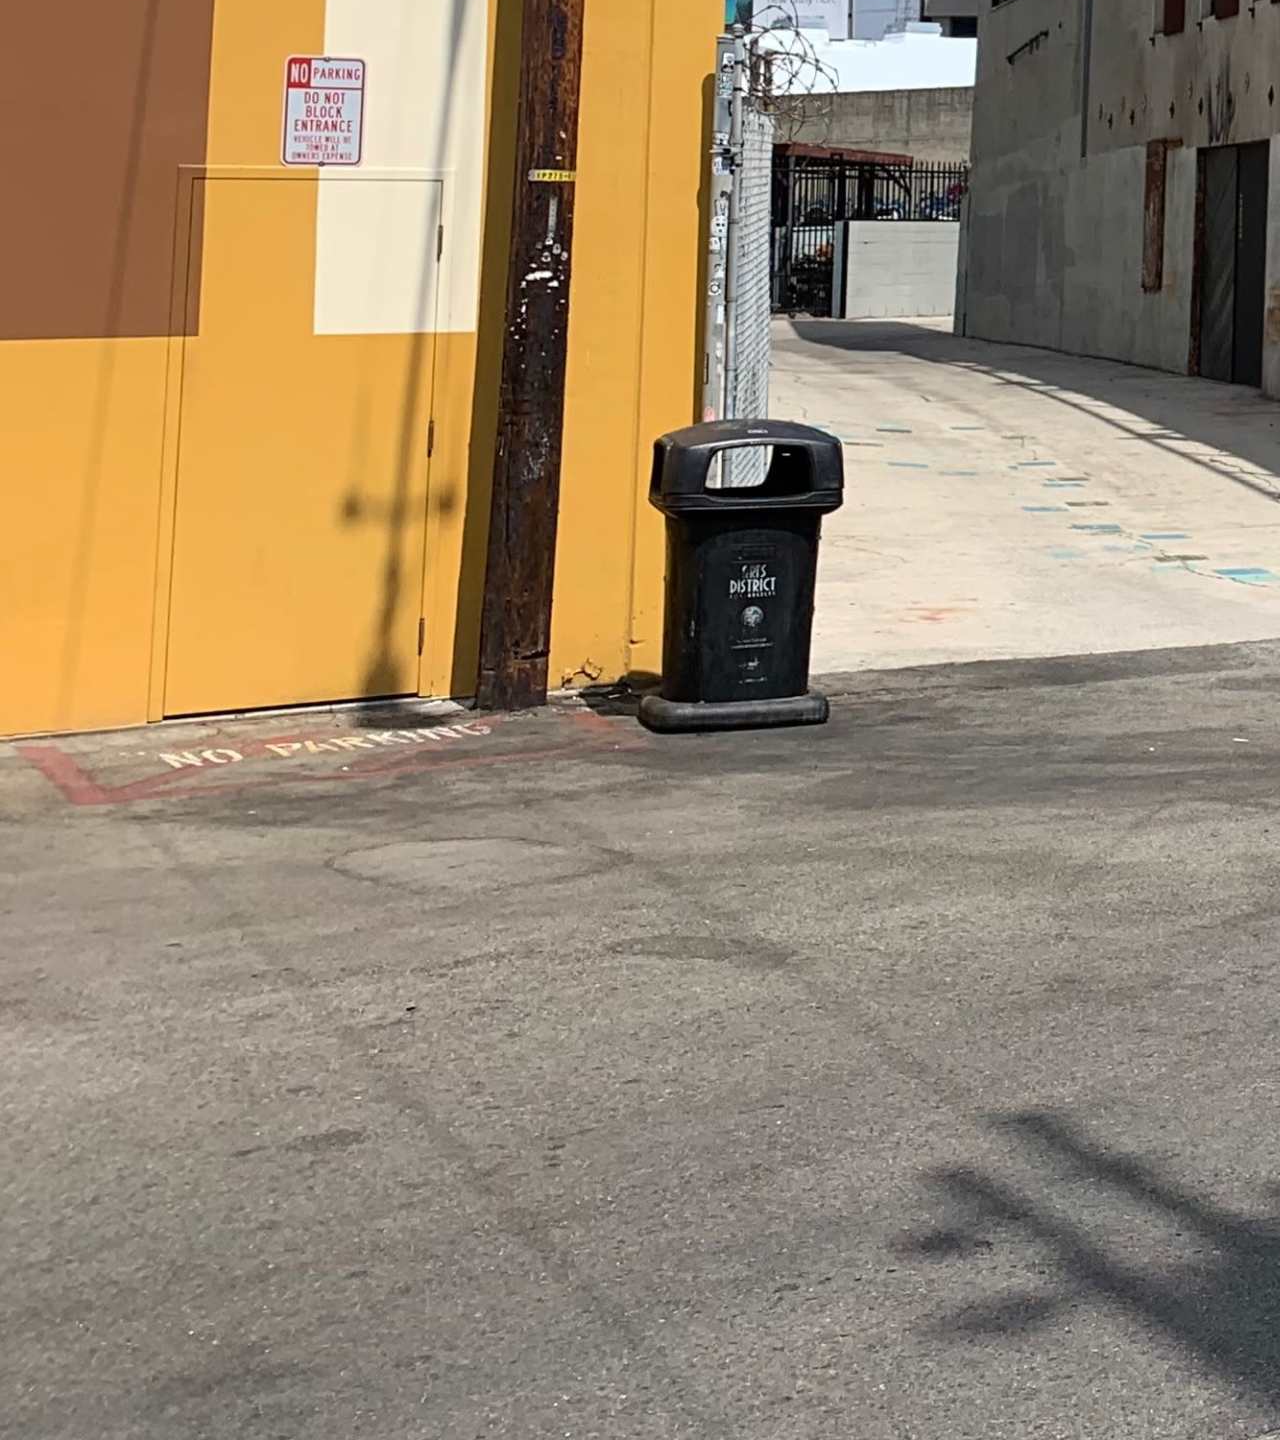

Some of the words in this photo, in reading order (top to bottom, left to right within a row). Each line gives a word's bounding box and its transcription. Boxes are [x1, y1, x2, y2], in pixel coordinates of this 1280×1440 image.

[290, 63, 309, 83] NO
[313, 67, 361, 81] PARKING
[304, 91, 319, 104] DO
[324, 92, 346, 105] NOT
[305, 105, 343, 118] BLOCK
[294, 119, 353, 133] ENTRANCE
[729, 576, 777, 594] DISTRICT
[159, 750, 244, 769] NO
[264, 721, 494, 758] PARKING
